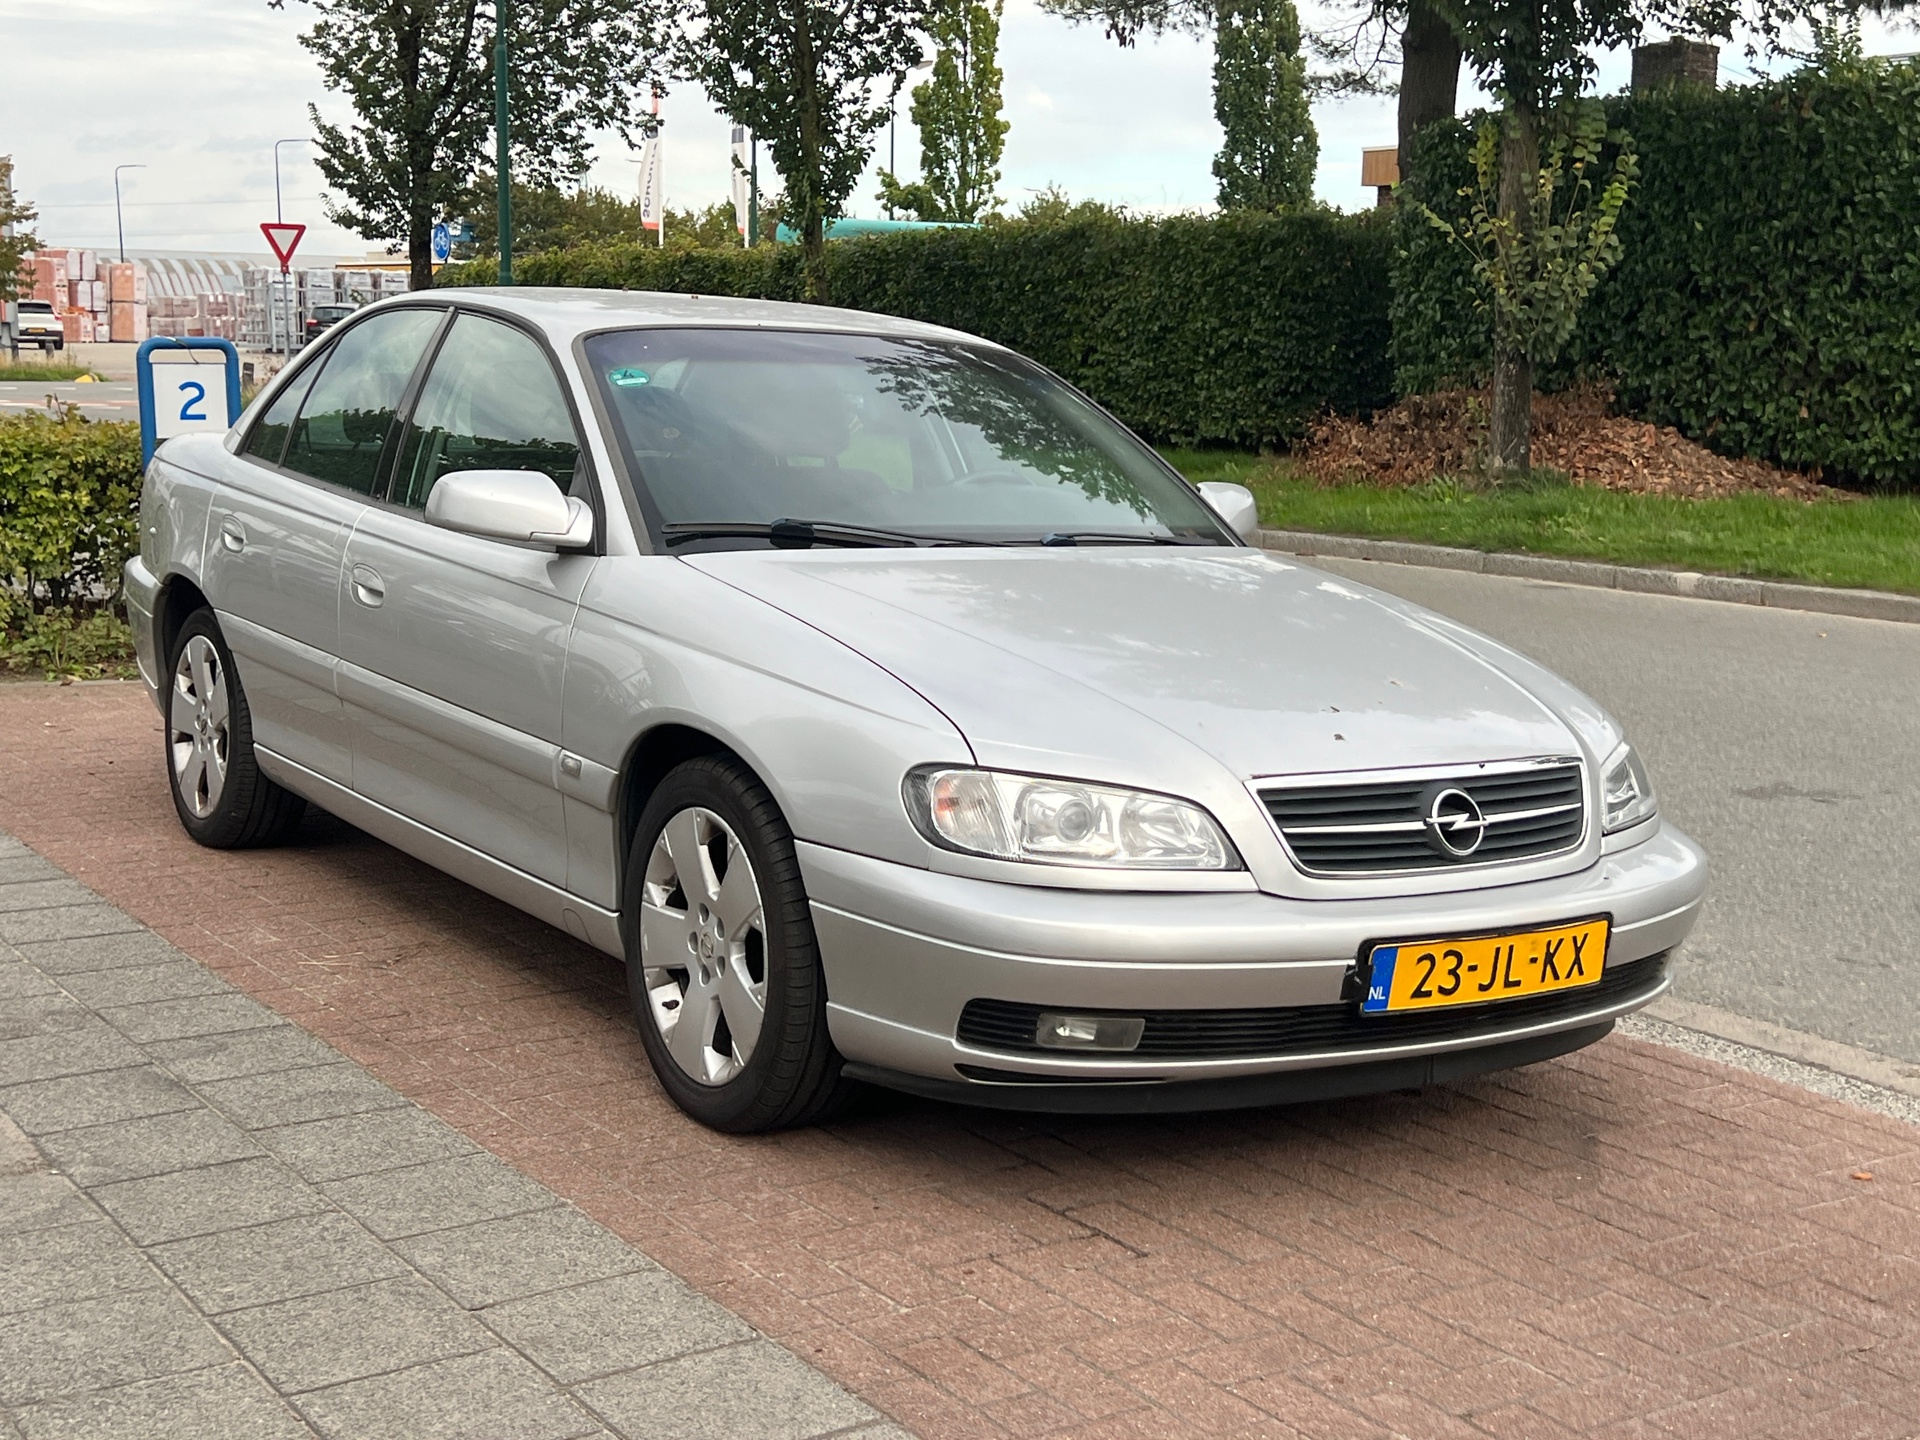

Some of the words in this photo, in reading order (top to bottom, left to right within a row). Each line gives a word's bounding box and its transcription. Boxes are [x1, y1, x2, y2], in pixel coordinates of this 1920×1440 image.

[178, 381, 207, 420] 2
[1410, 933, 1589, 999] 23-JL-KX
[1368, 985, 1386, 1000] NL
